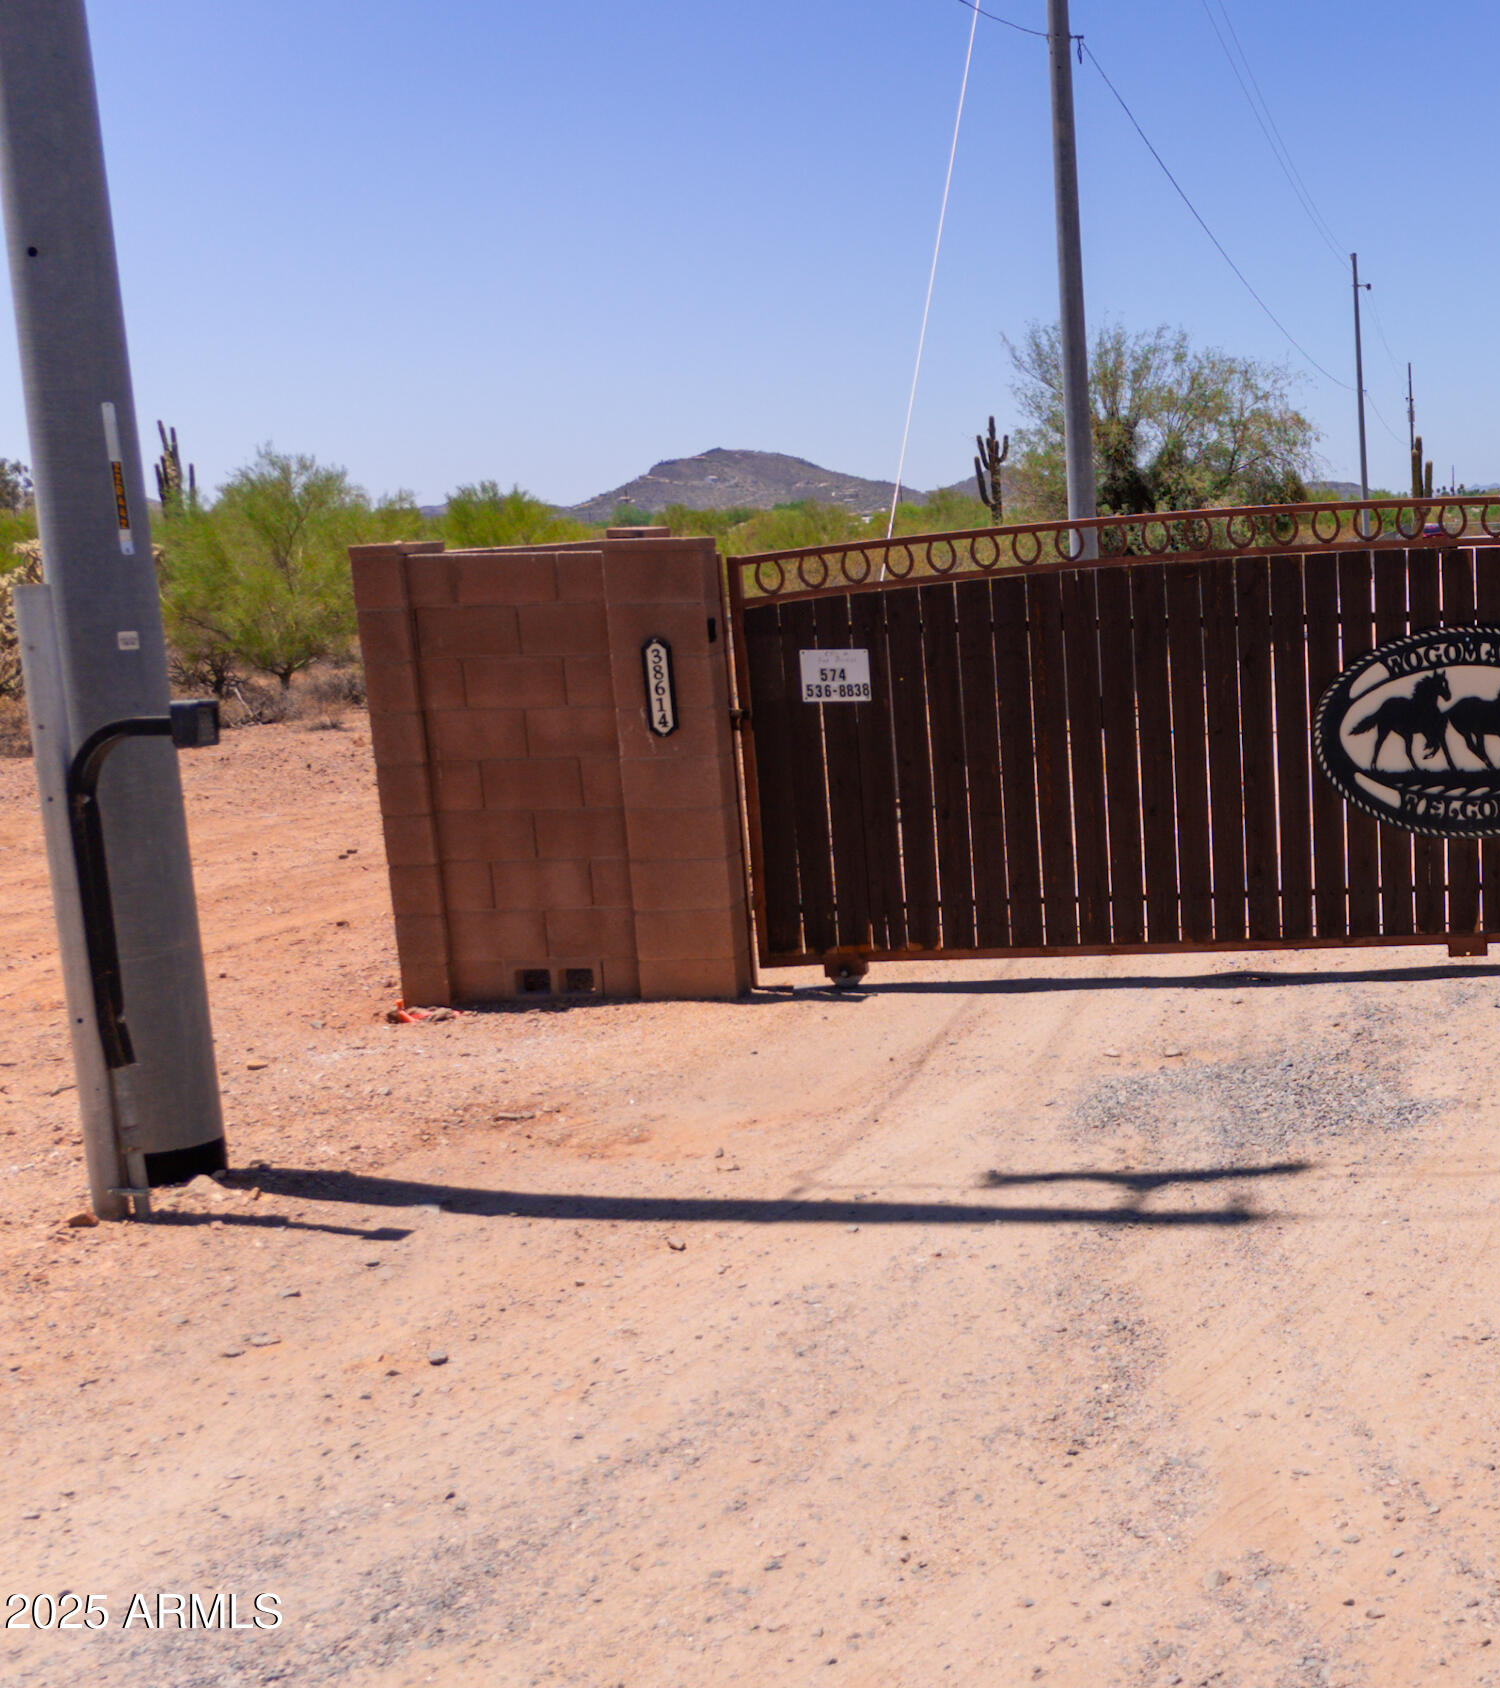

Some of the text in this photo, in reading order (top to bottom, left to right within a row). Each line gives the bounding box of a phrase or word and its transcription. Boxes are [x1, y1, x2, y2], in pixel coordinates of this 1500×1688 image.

[820, 668, 846, 682] 574
[651, 649, 669, 728] 38614
[806, 683, 870, 698] 536-8838
